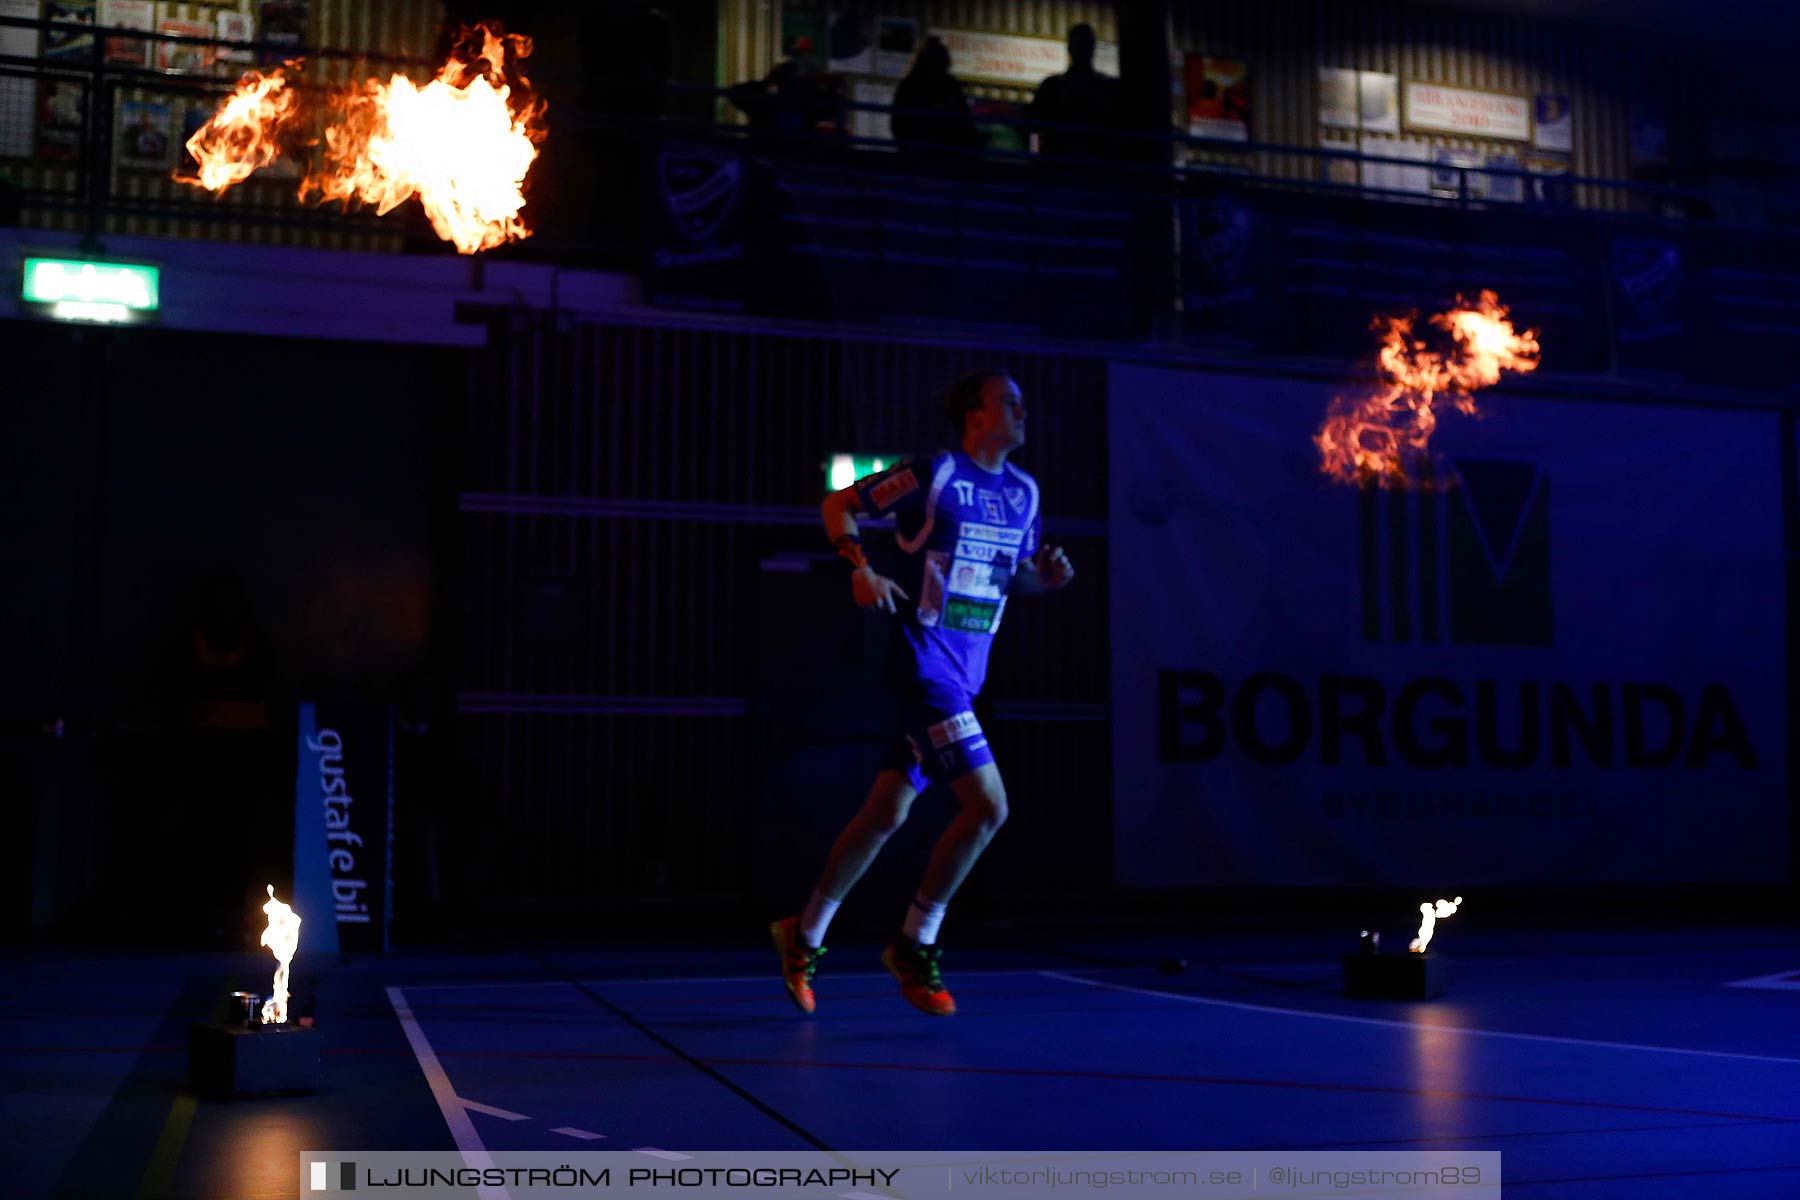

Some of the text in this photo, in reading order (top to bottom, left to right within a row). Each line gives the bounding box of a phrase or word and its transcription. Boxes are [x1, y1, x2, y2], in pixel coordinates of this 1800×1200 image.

[952, 480, 975, 507] 17
[1158, 669, 1756, 769] BORGUNDA
[331, 880, 371, 923] bil
